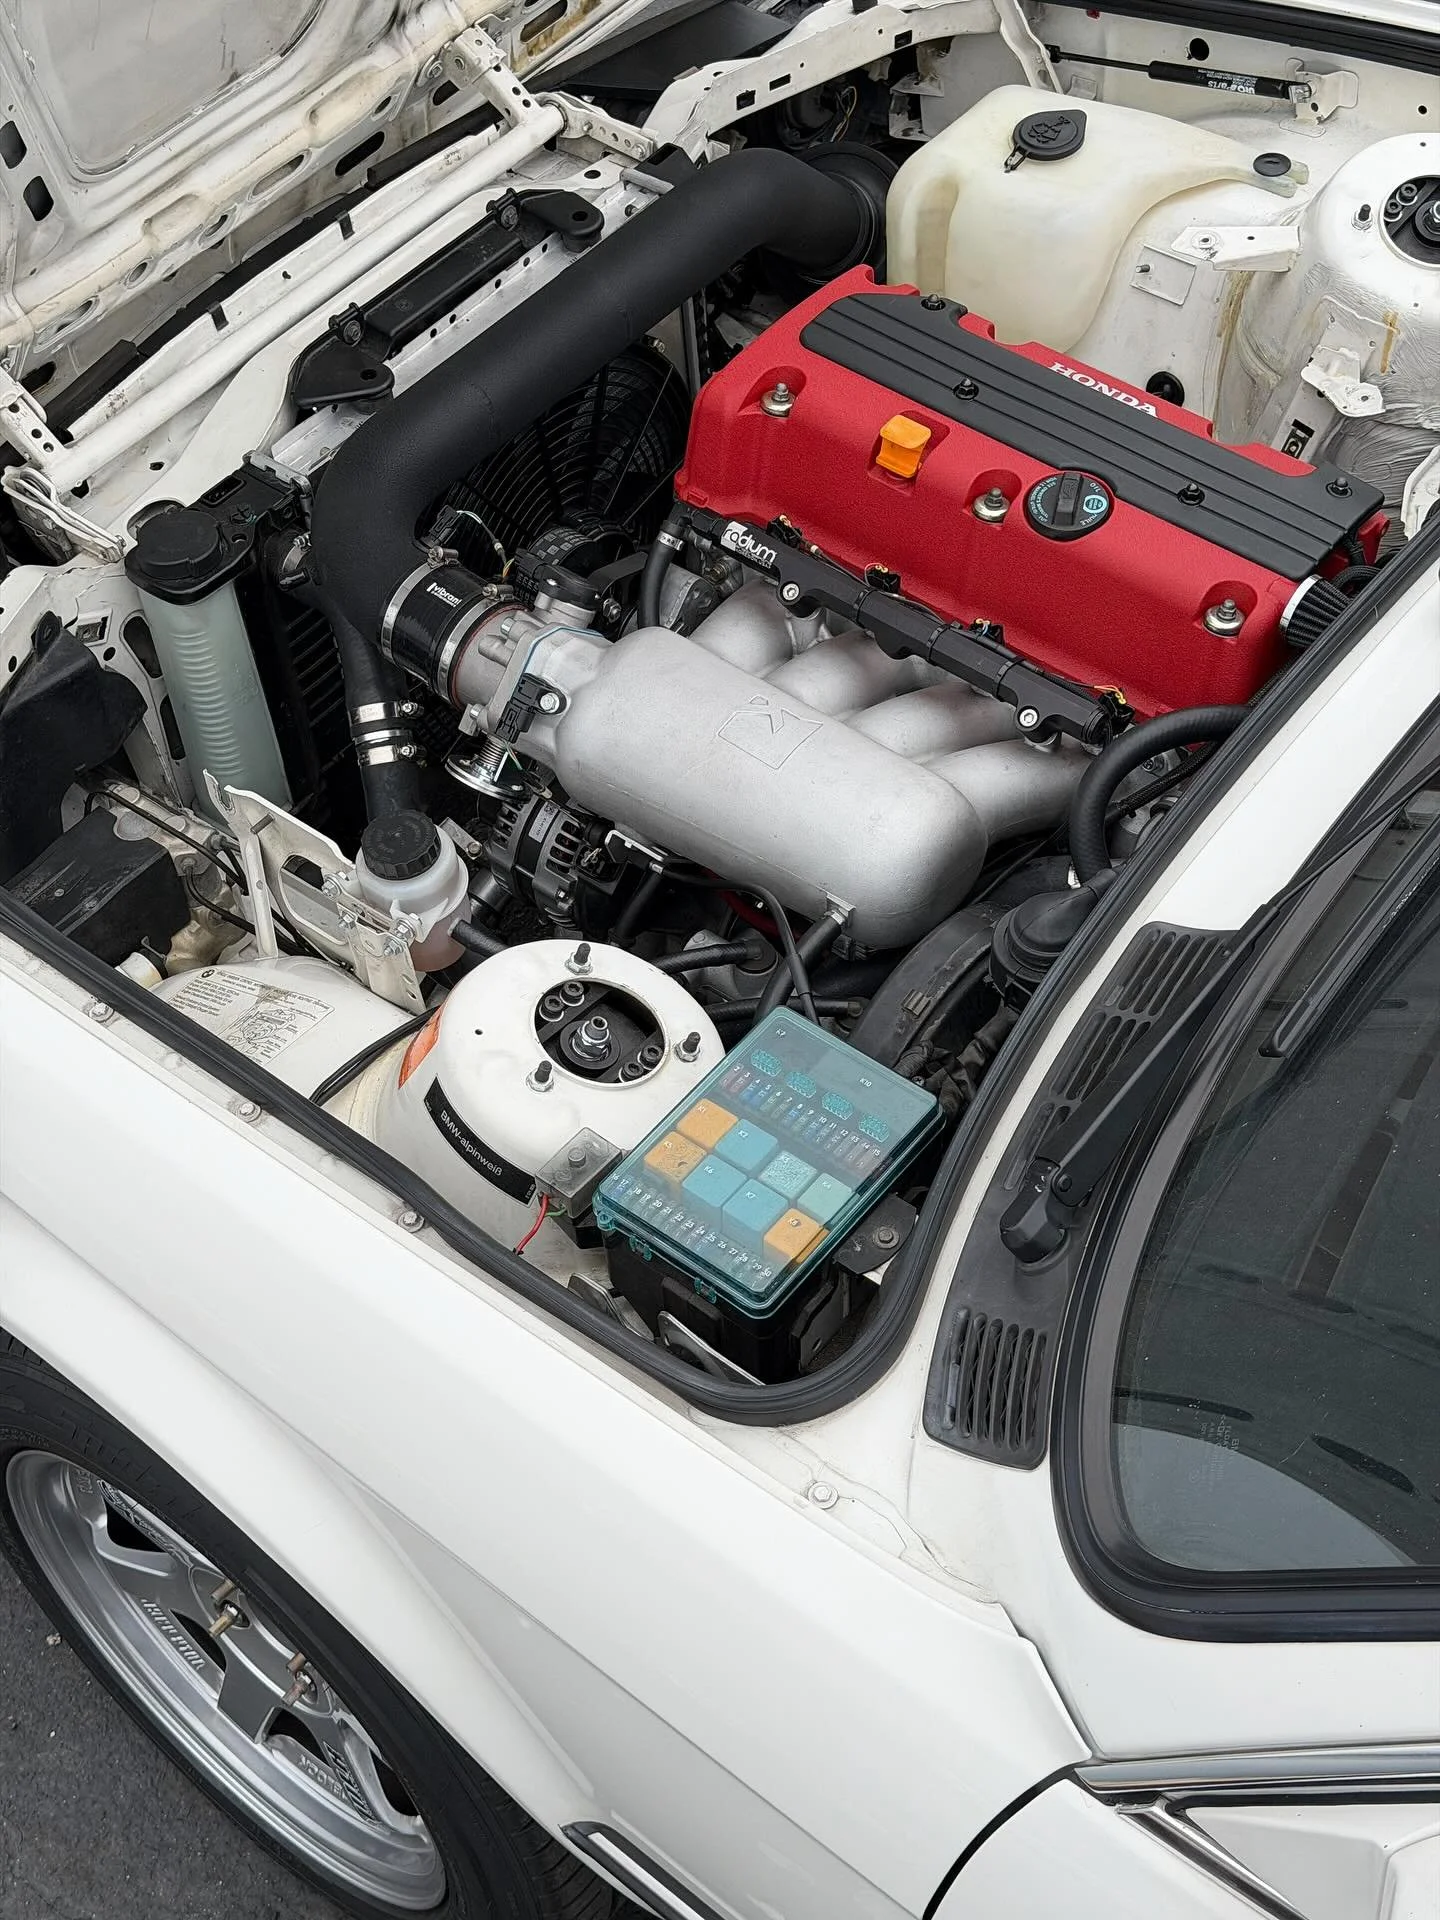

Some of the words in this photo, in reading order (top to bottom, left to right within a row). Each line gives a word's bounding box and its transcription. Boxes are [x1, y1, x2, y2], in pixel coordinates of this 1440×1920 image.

[1048, 361, 1159, 419] HONDA
[1089, 482, 1102, 493] OIL
[722, 528, 778, 563] radium
[434, 584, 463, 606] vibrant
[859, 1077, 872, 1087] K10
[440, 1109, 503, 1177] BMW-alpinweiß
[703, 1165, 715, 1174] K6
[745, 1191, 756, 1199] K7
[633, 1187, 642, 1195] 18
[642, 1193, 651, 1201] 19
[652, 1200, 663, 1208] 20
[663, 1206, 672, 1214] 21
[717, 1241, 727, 1249] 26
[728, 1247, 739, 1255] 27
[752, 1262, 762, 1270] 29
